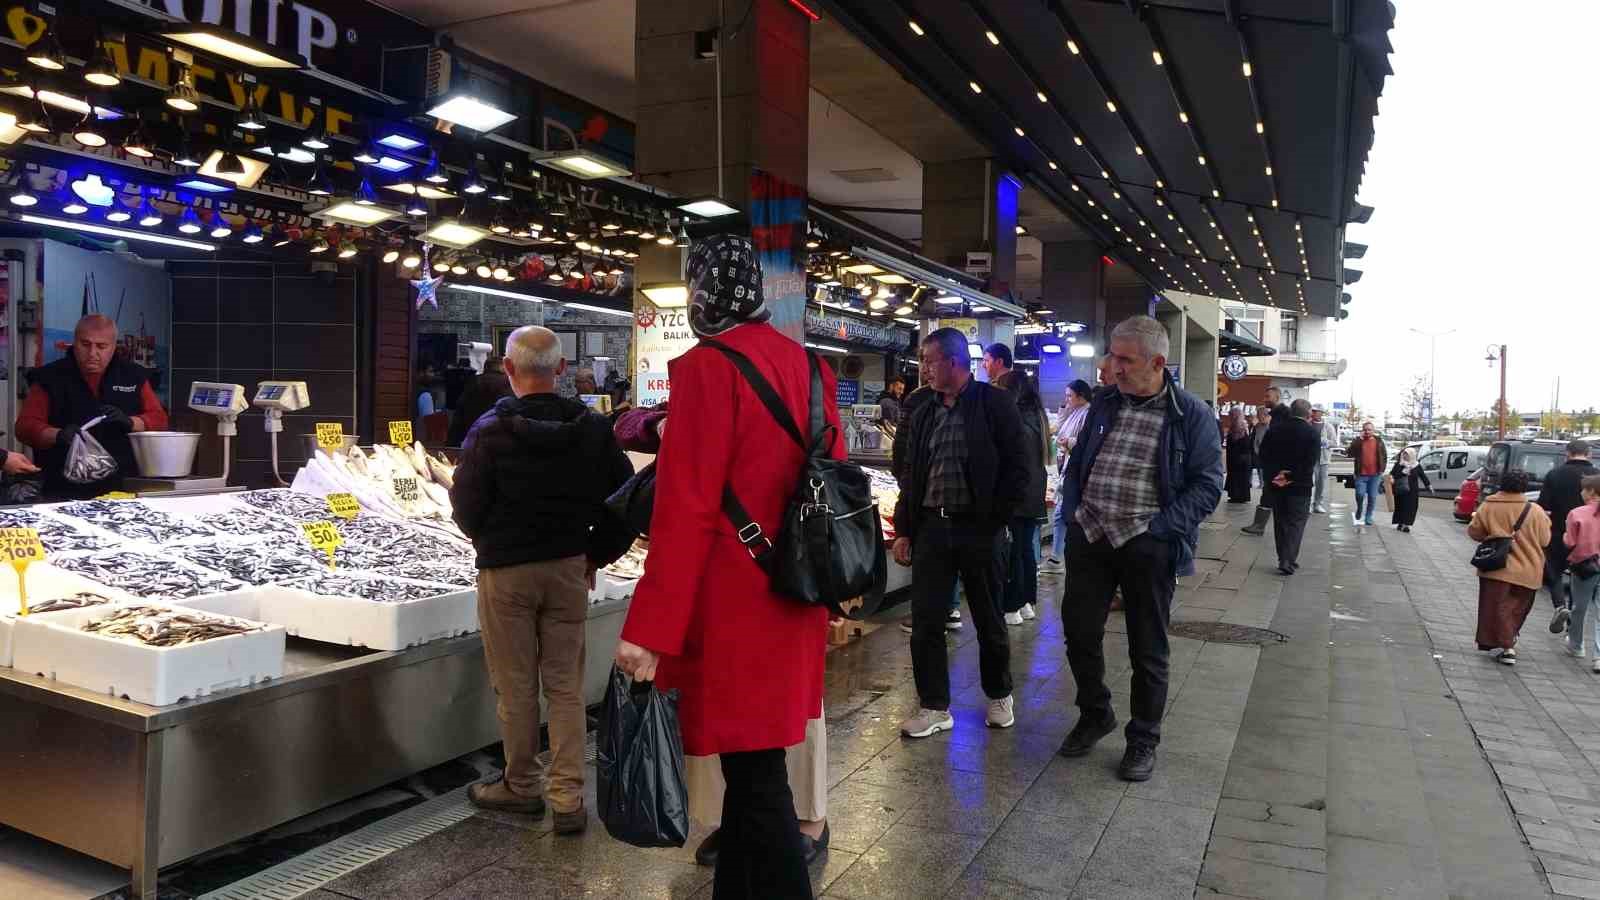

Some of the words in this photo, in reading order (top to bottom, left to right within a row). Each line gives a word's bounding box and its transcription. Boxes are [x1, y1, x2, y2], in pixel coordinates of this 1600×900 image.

[663, 331, 690, 340] BALIK
[640, 398, 658, 406] VISA
[4, 547, 37, 561] 100
